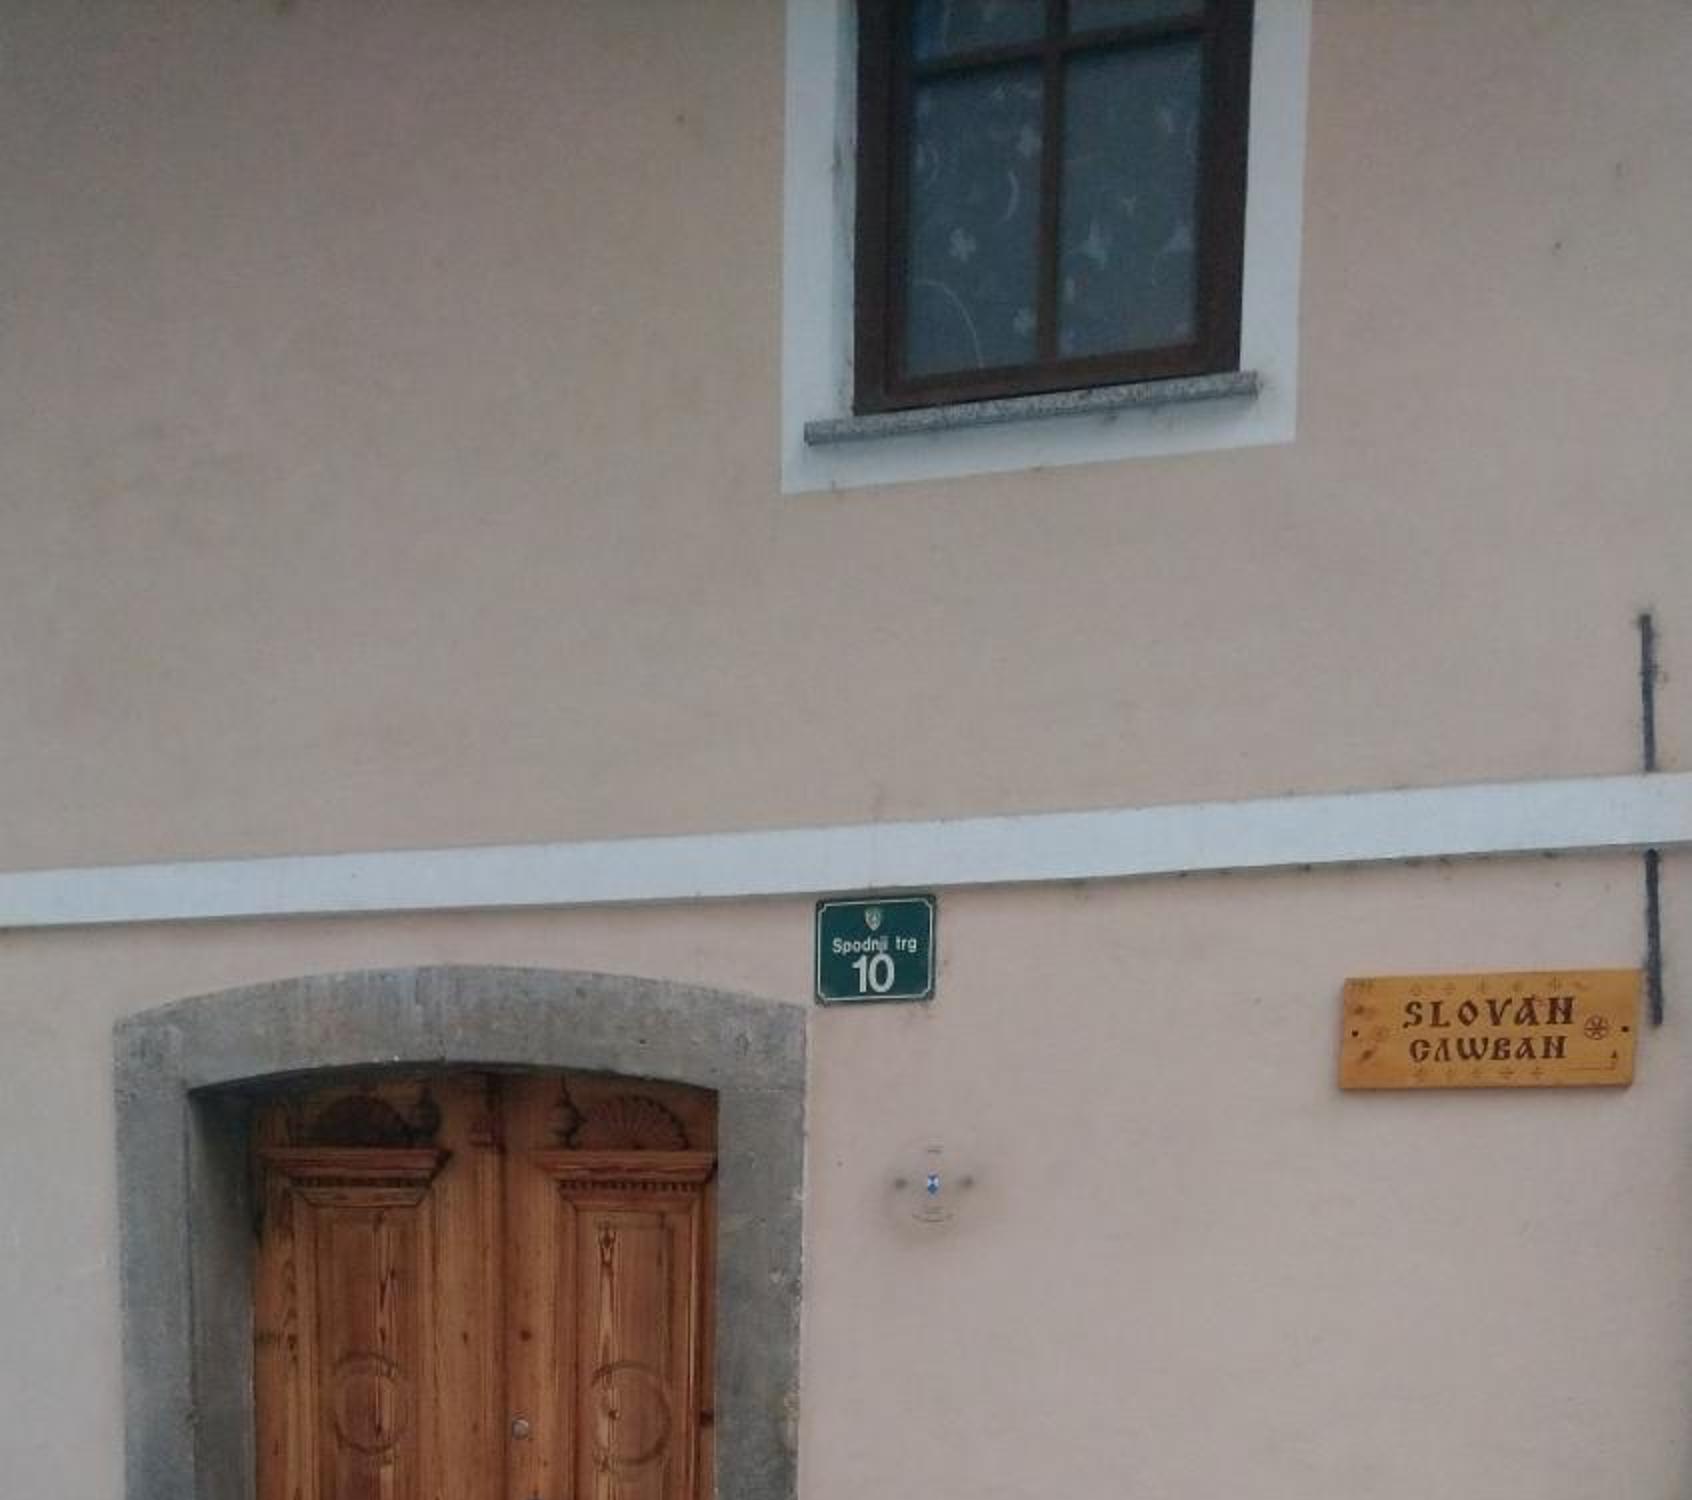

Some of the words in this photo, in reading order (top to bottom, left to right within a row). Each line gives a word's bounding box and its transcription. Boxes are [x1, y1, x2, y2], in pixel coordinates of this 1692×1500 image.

[895, 935, 917, 953] trg
[851, 953, 895, 993] 10
[1402, 995, 1576, 1029] SLOVAN
